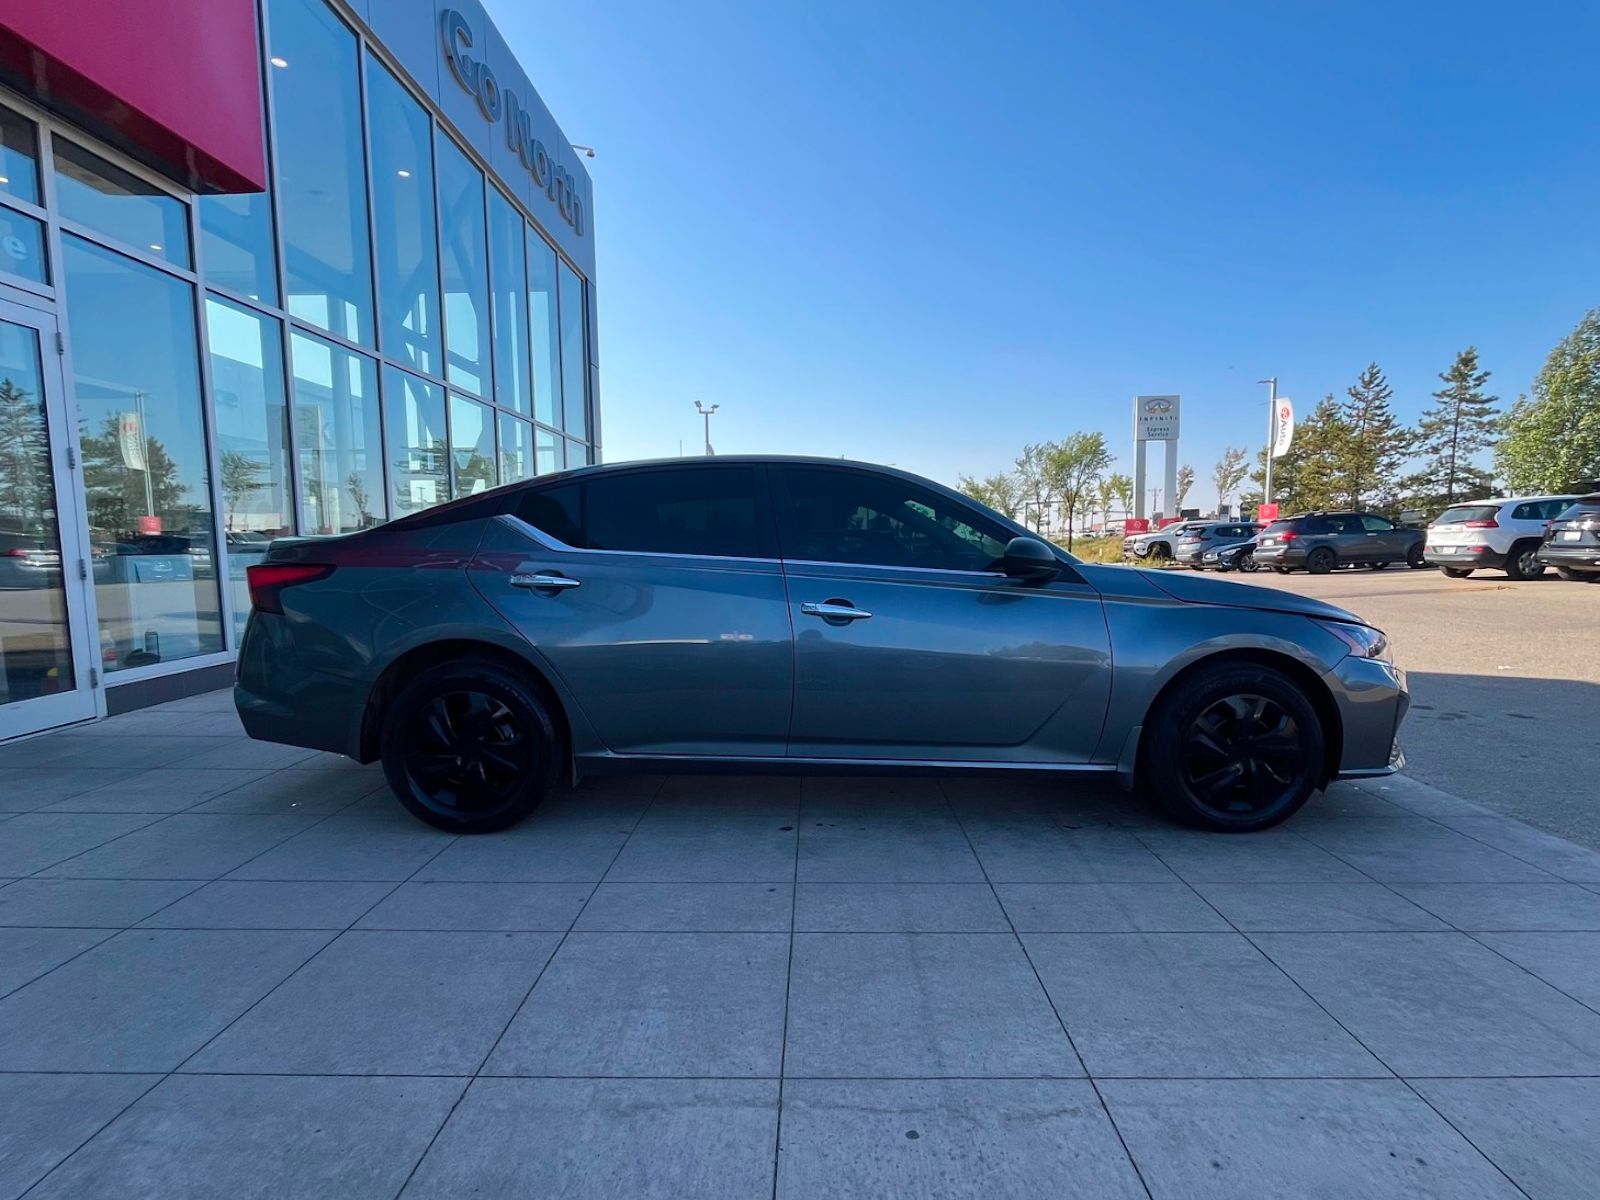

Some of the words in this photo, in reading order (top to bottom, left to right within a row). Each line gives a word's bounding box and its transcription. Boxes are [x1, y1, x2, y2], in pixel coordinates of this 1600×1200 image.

[441, 8, 501, 124] Go
[504, 88, 584, 237] North
[1279, 419, 1288, 446] Auto
